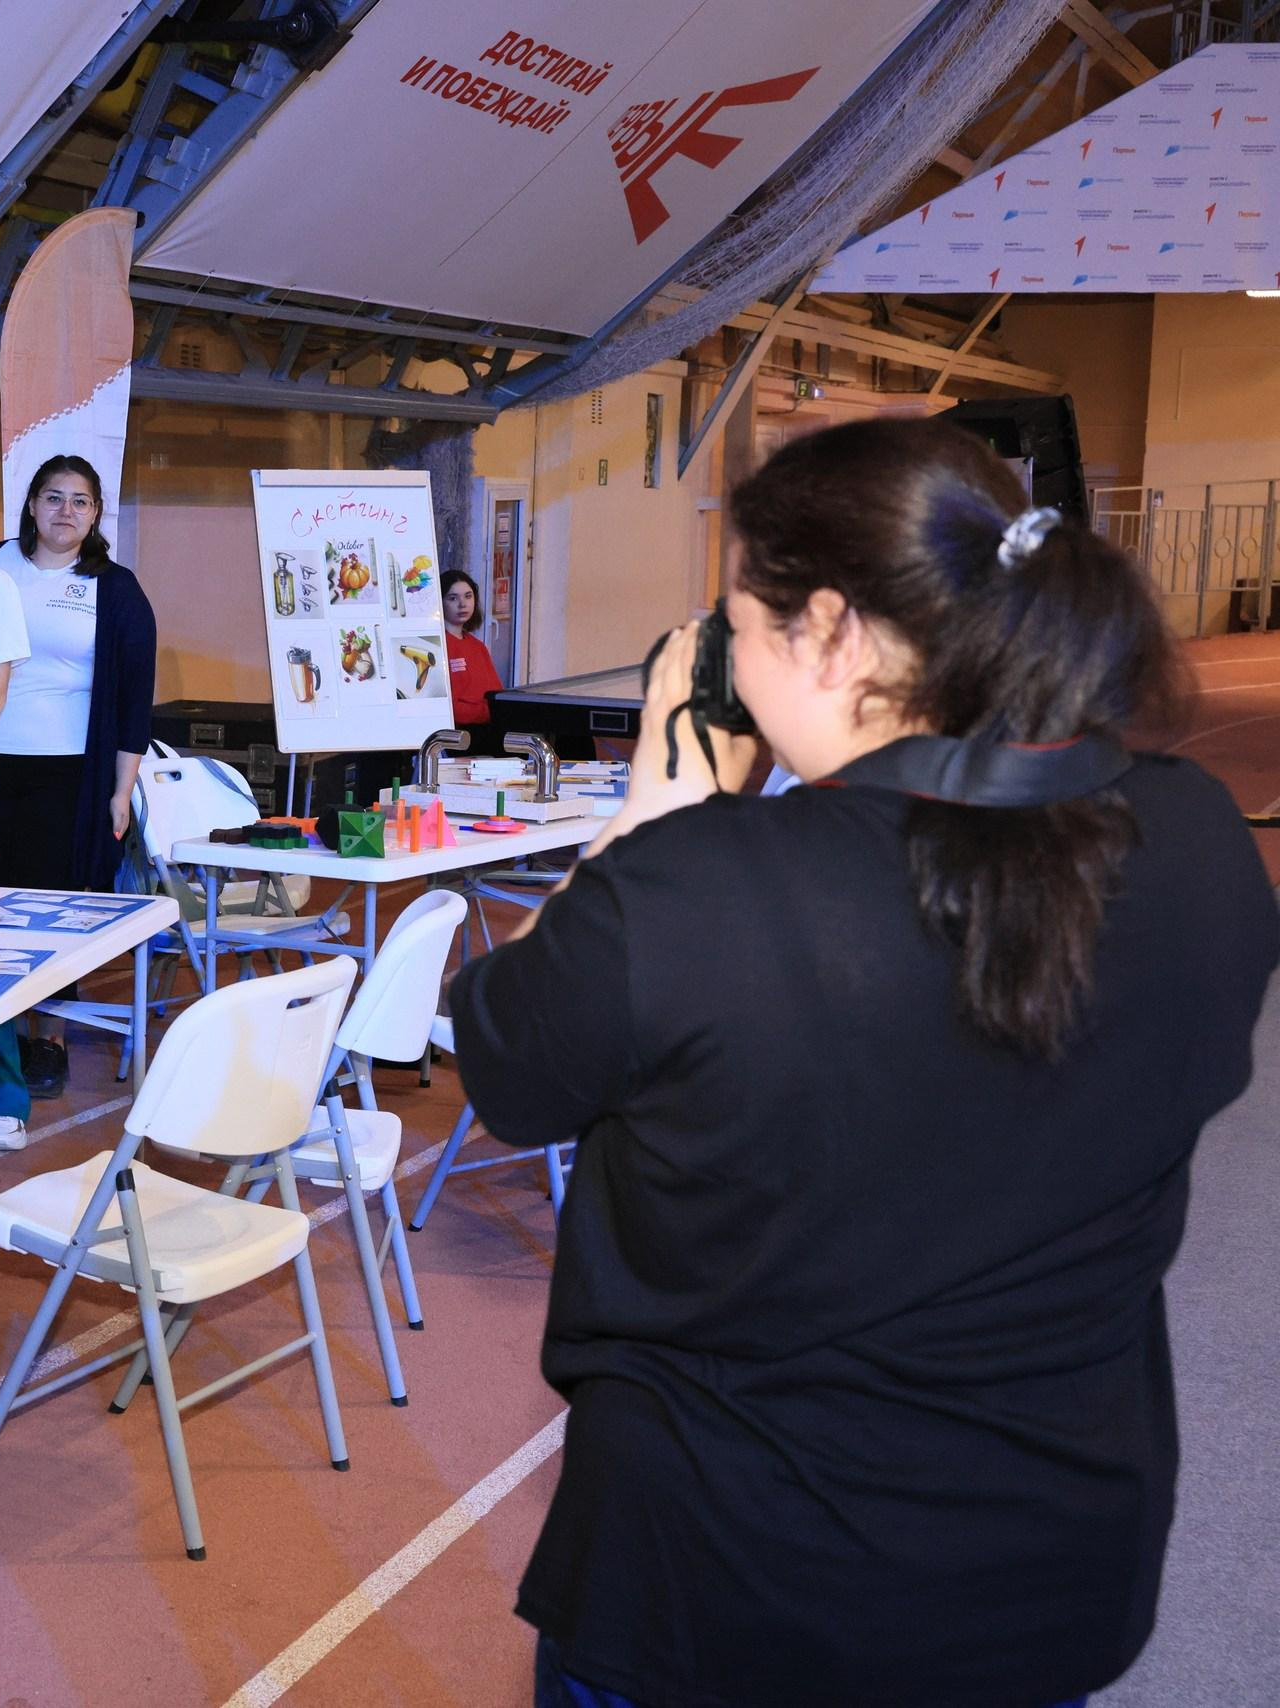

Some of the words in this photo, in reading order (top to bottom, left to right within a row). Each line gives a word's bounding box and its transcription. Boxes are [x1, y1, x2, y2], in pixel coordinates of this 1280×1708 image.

[399, 55, 438, 87] И
[421, 63, 572, 135] ПОБЕЖДАЙ!
[478, 30, 614, 96] ДОСТИГАЙ
[337, 539, 365, 551] October
